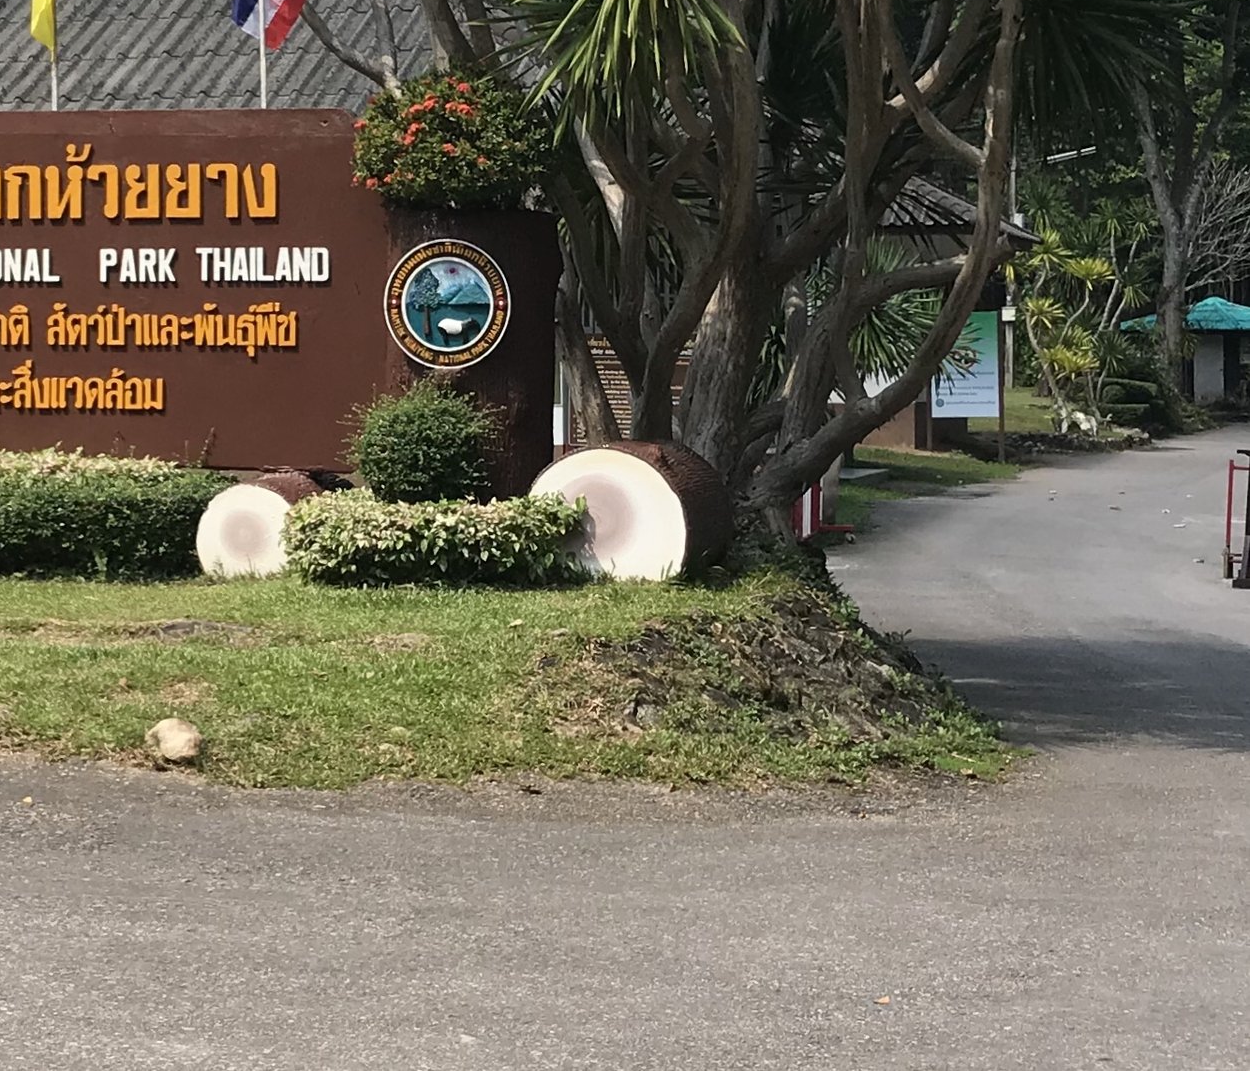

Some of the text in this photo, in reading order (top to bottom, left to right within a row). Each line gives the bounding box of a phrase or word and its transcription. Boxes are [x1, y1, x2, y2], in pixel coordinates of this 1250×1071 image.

[98, 247, 177, 283] PARK
[195, 245, 330, 282] THAILAND
[46, 301, 297, 357] สัตว์ป่าและพันธุ์พืช
